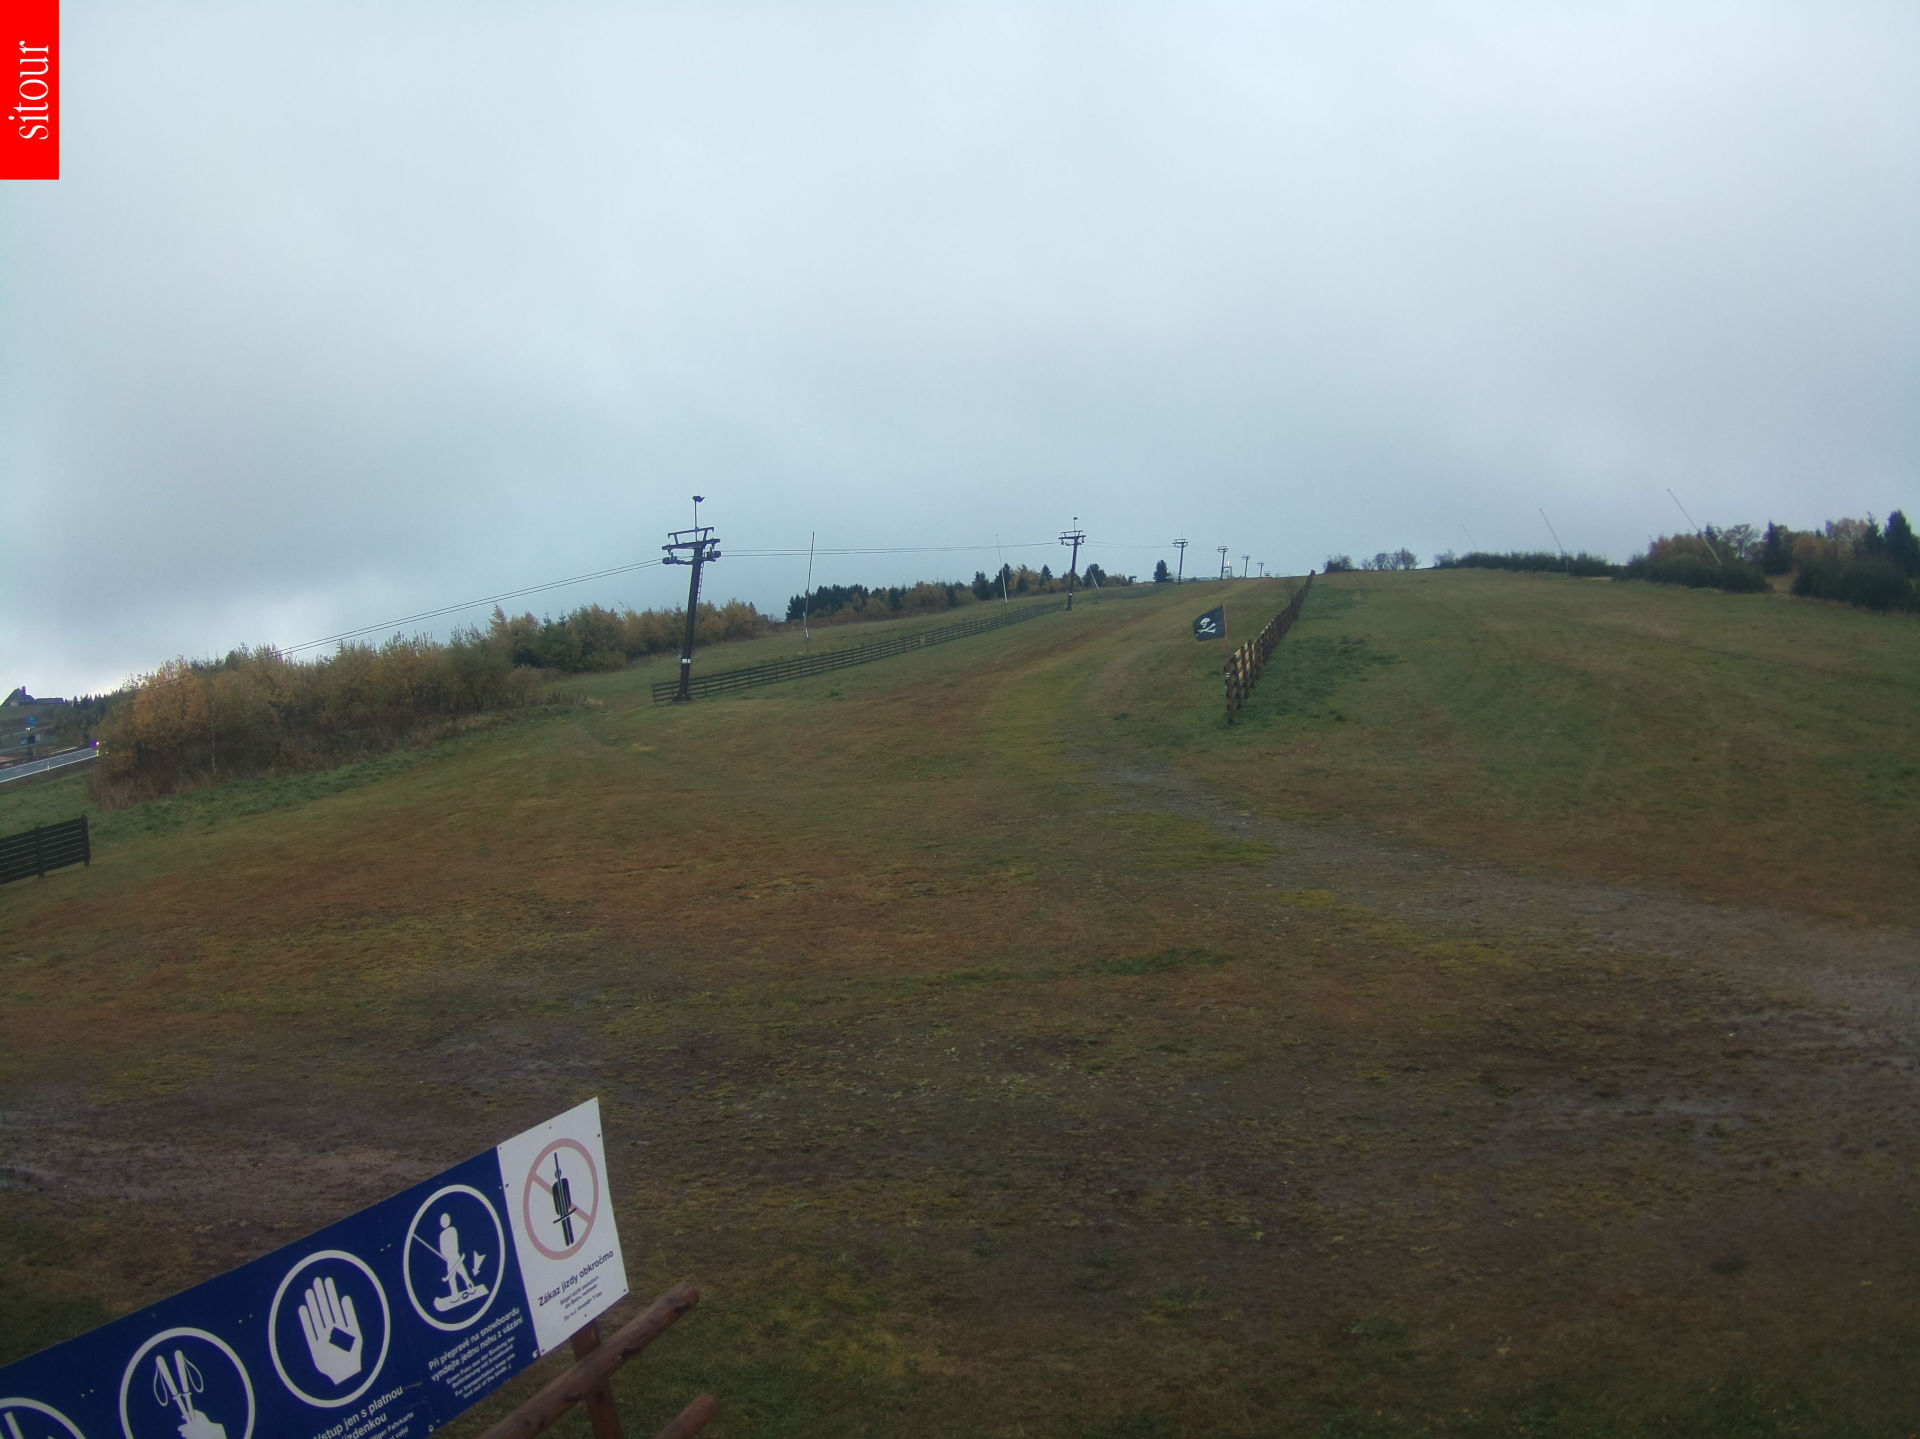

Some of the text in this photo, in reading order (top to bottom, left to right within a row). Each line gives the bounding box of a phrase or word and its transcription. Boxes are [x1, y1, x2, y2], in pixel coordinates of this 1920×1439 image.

[538, 1286, 560, 1307] Zákaz
[579, 1250, 614, 1278] obkročmo
[431, 1359, 460, 1381] vyndejte
[461, 1346, 480, 1364] jednu
[480, 1334, 497, 1349] nohu
[440, 1337, 470, 1365] přepravě
[470, 1333, 480, 1343] na
[480, 1307, 520, 1337] snowboardu
[343, 1413, 360, 1431] jen
[361, 1409, 368, 1418] s
[368, 1386, 404, 1415] platnou
